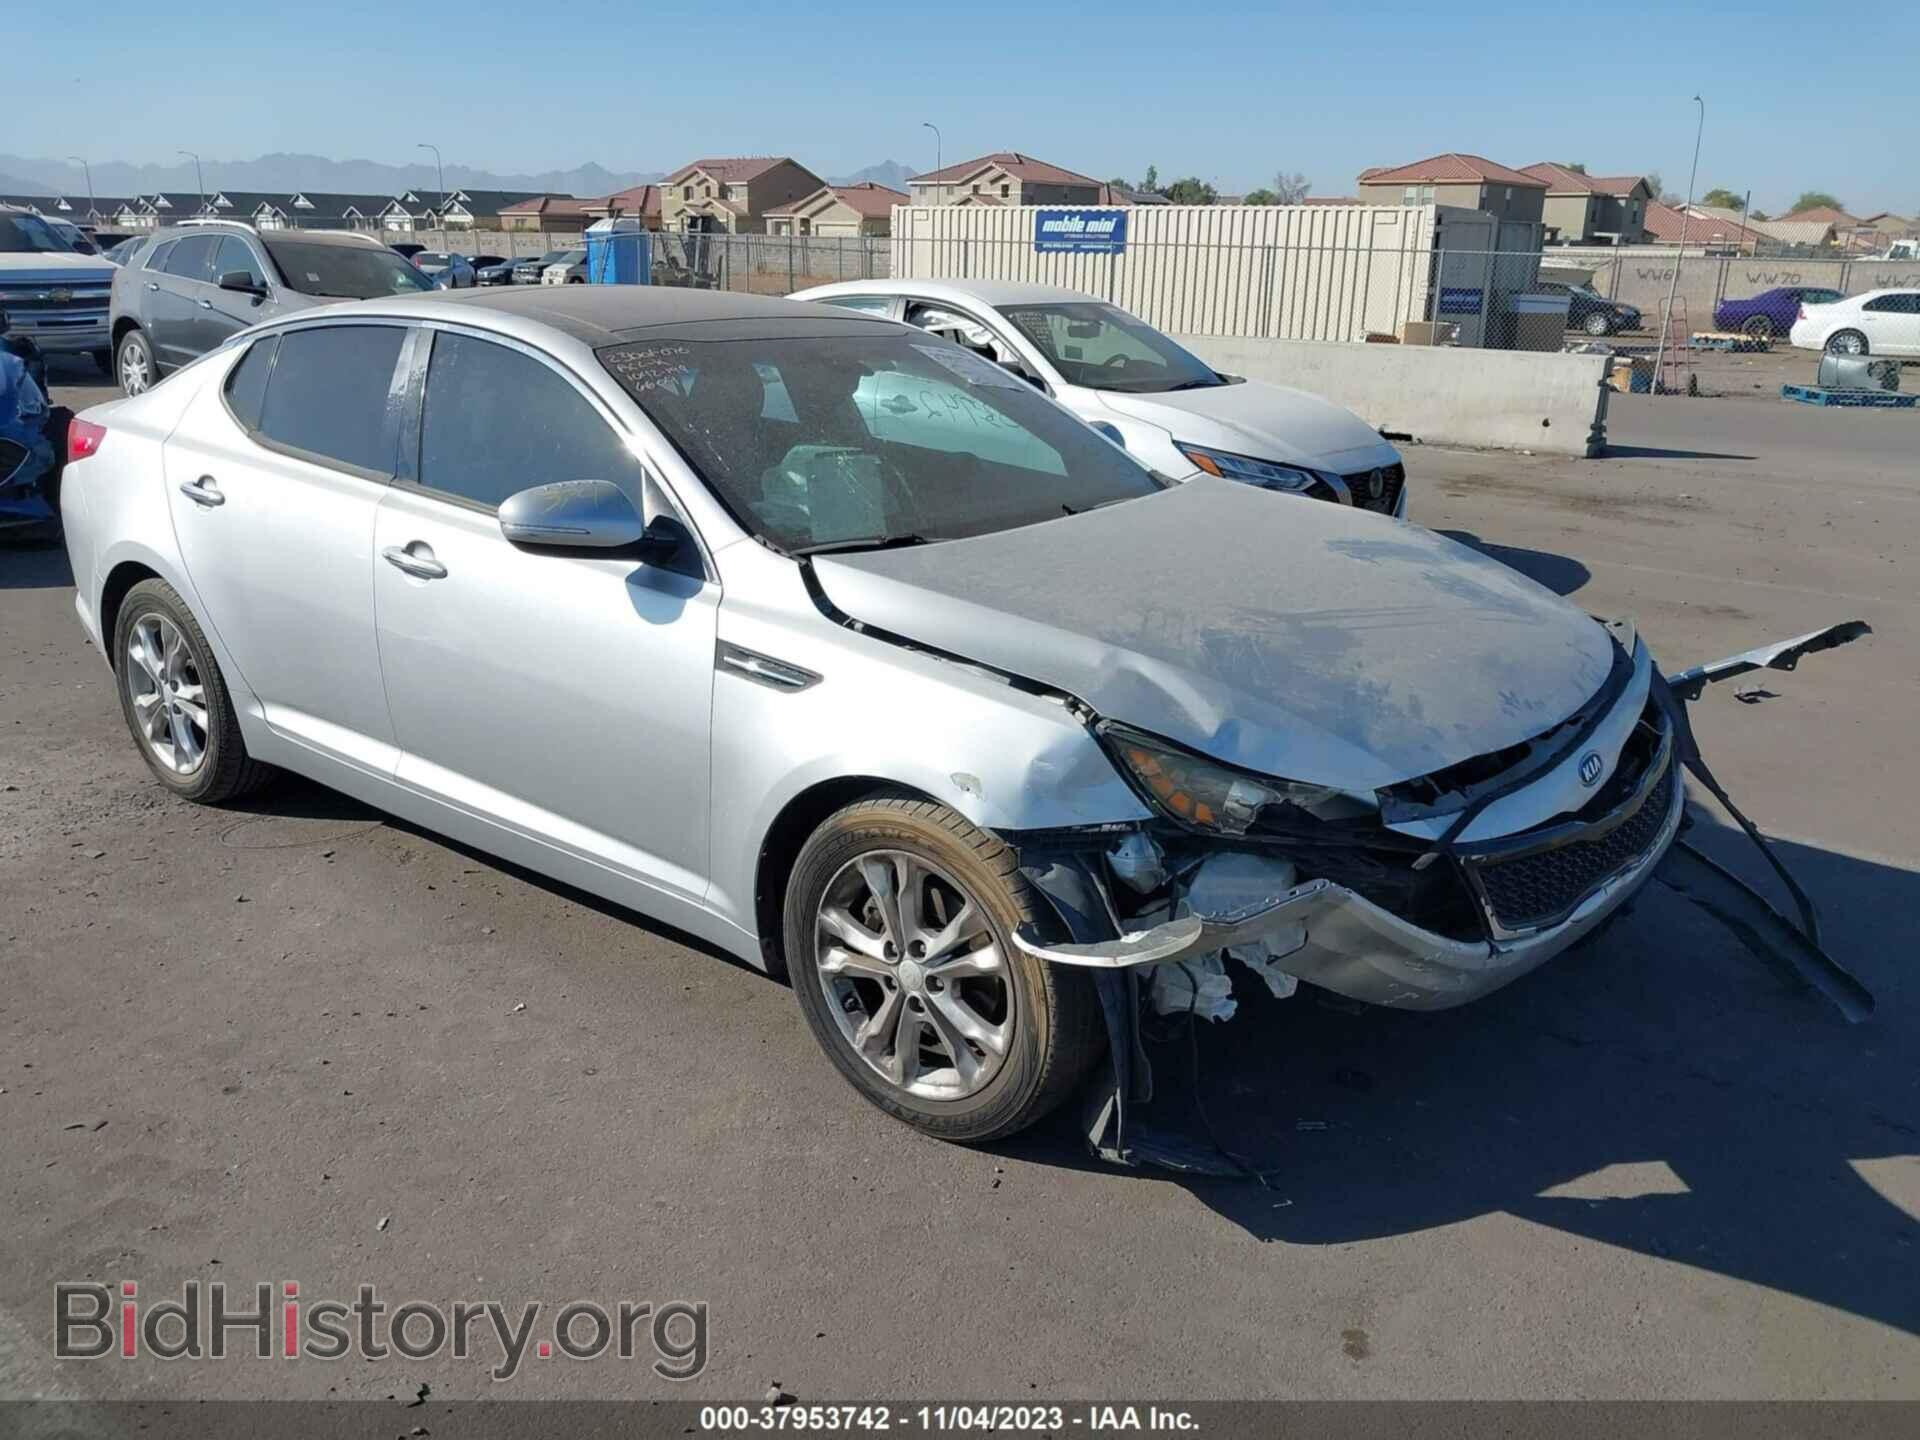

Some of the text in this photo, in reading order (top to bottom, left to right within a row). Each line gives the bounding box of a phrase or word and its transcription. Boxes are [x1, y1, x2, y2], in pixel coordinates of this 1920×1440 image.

[1042, 215, 1117, 233] mobile mini
[1746, 271, 1801, 285] WW70
[1582, 755, 1601, 782] KIA
